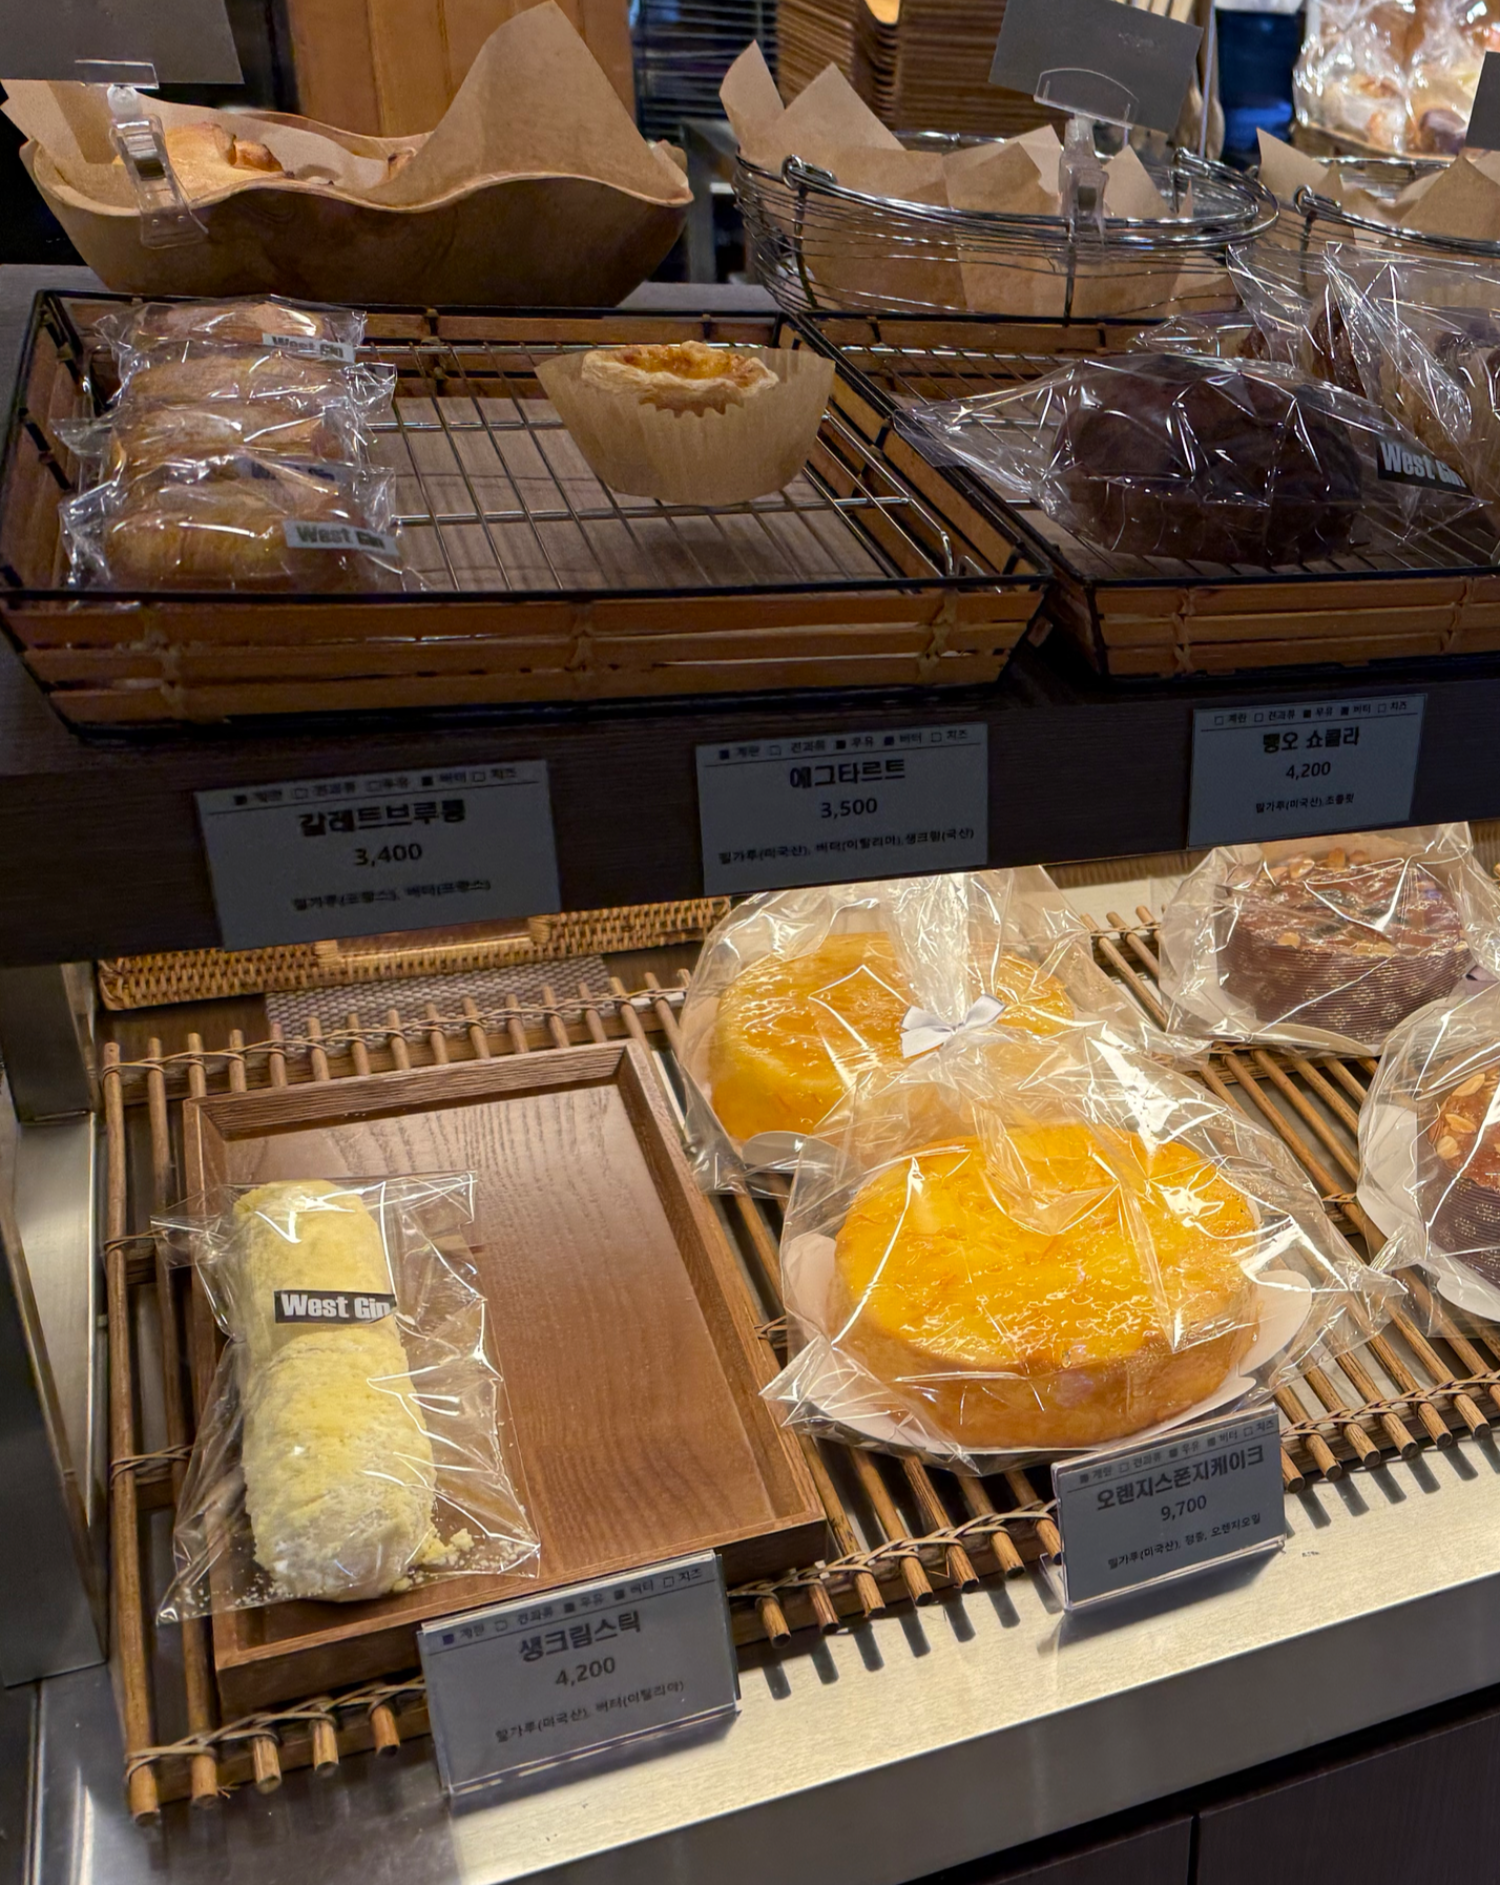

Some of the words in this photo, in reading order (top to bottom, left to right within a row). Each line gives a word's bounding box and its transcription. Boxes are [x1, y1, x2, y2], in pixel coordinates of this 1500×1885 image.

[1381, 440, 1436, 480] West
[296, 525, 353, 544] West
[1306, 726, 1360, 748] 쇼콜라
[1286, 761, 1331, 780] 4,200
[820, 798, 878, 819] 3,500
[354, 843, 423, 867] 3,400
[281, 1293, 349, 1318] West
[354, 1297, 391, 1320] Gin
[1096, 1445, 1264, 1511] 오렌지스폰지케이크
[1161, 1495, 1207, 1521] 9,700
[1210, 1513, 1262, 1537] 오렌지오일
[519, 1609, 641, 1663] 생크림스틱
[554, 1656, 616, 1687] 4,200
